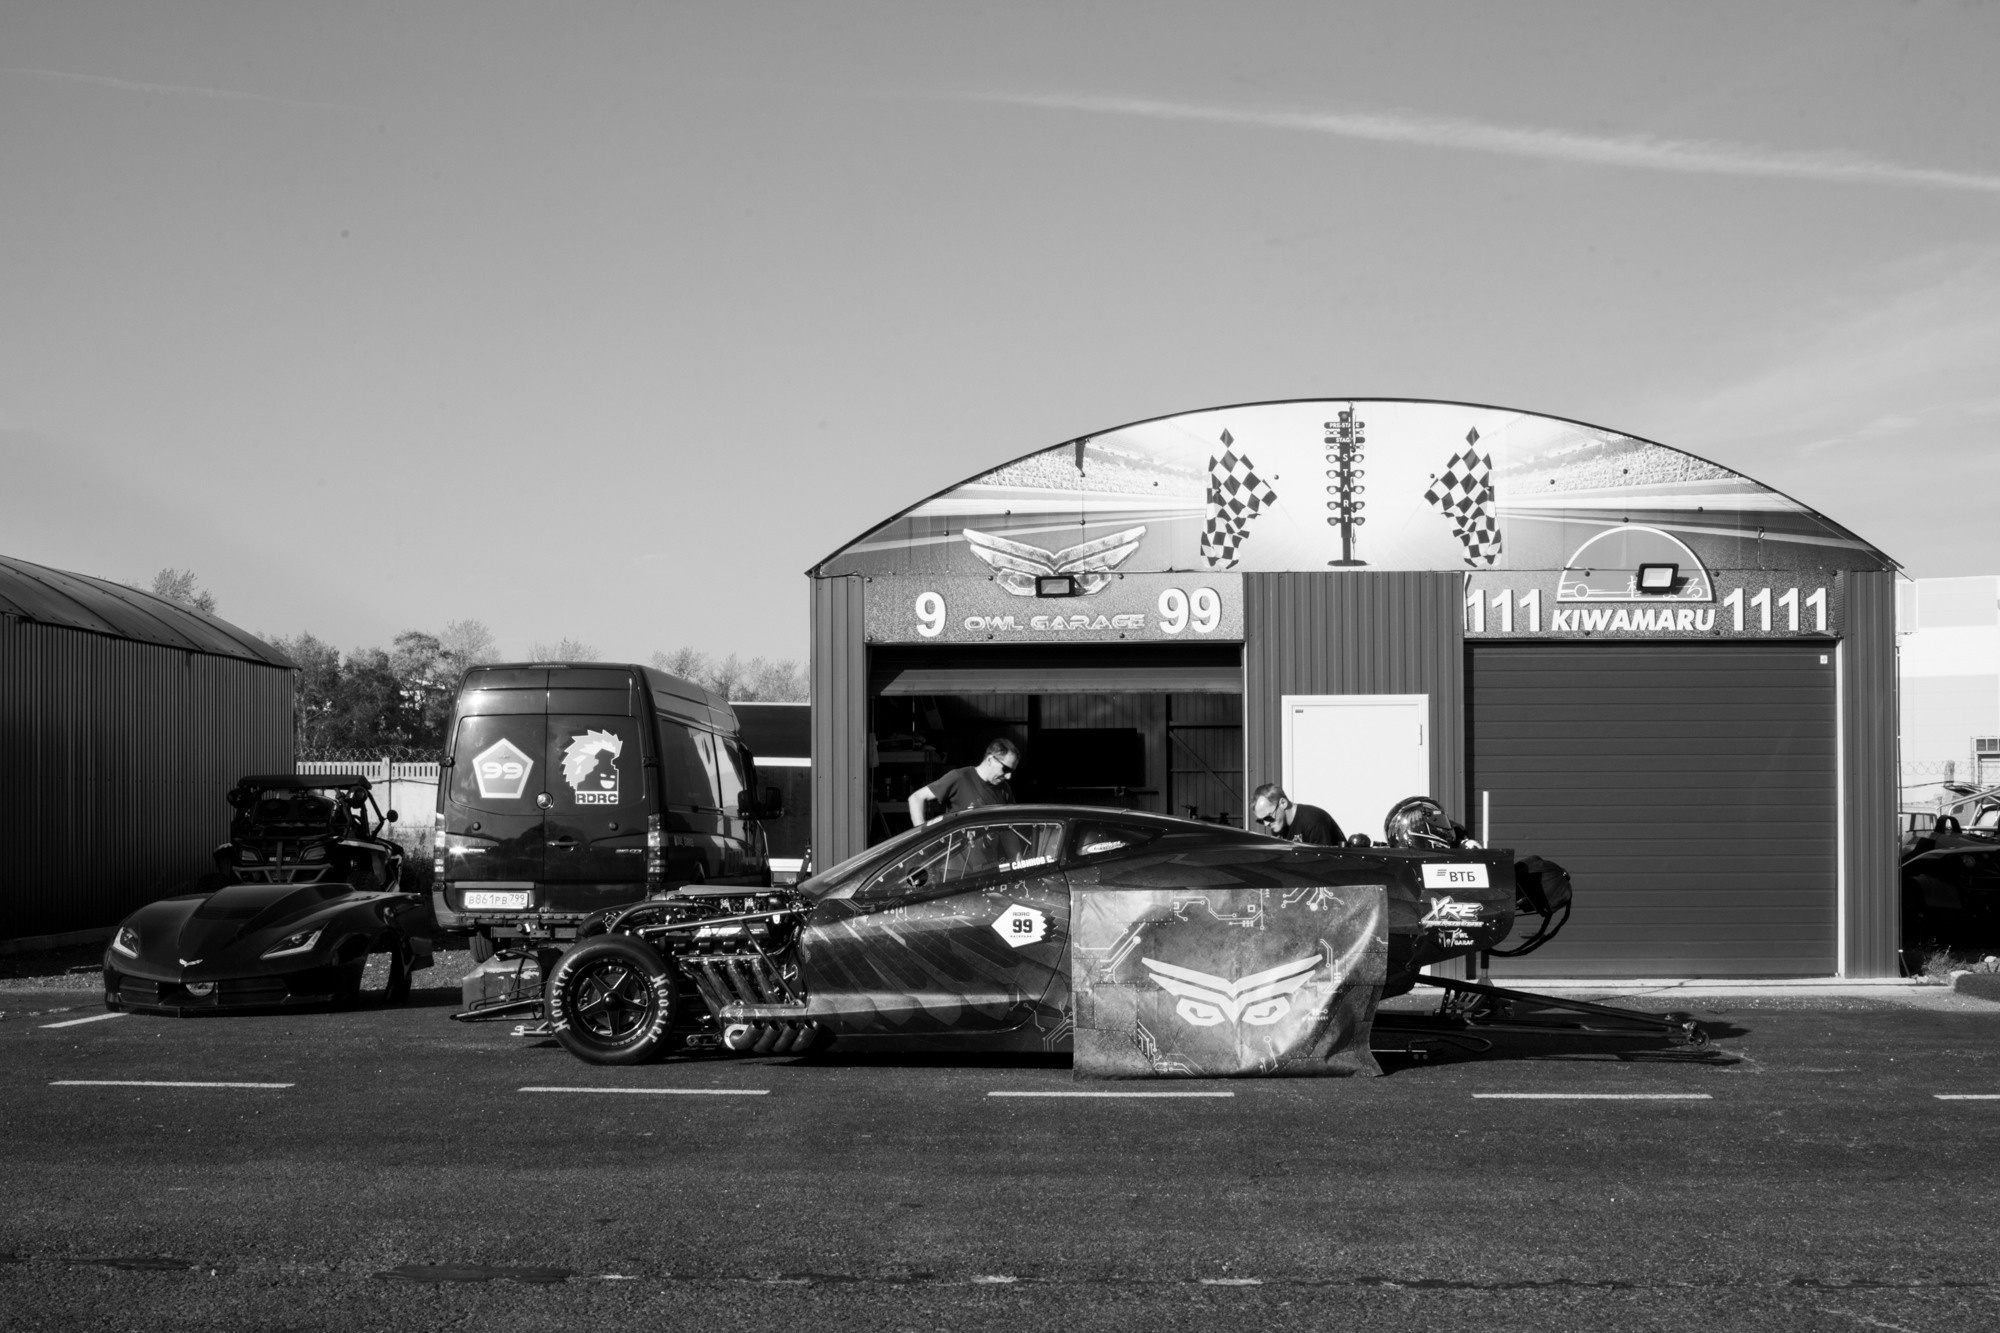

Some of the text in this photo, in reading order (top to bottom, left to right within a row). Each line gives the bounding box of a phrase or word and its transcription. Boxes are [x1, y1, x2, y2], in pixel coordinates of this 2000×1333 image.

[914, 591, 946, 637] 9
[1158, 587, 1222, 634] 99
[1551, 609, 1716, 631] KIWAMARU
[1723, 587, 1828, 632] 1111
[964, 614, 1146, 631] OWL GARAGE
[482, 761, 524, 779] 99
[576, 793, 618, 803] RDRC
[1449, 871, 1476, 883] ВТБ
[1421, 895, 1484, 921] XRE
[1012, 918, 1033, 934] 99
[550, 963, 573, 1033] Hoosier
[650, 972, 670, 1043] Hoosier
